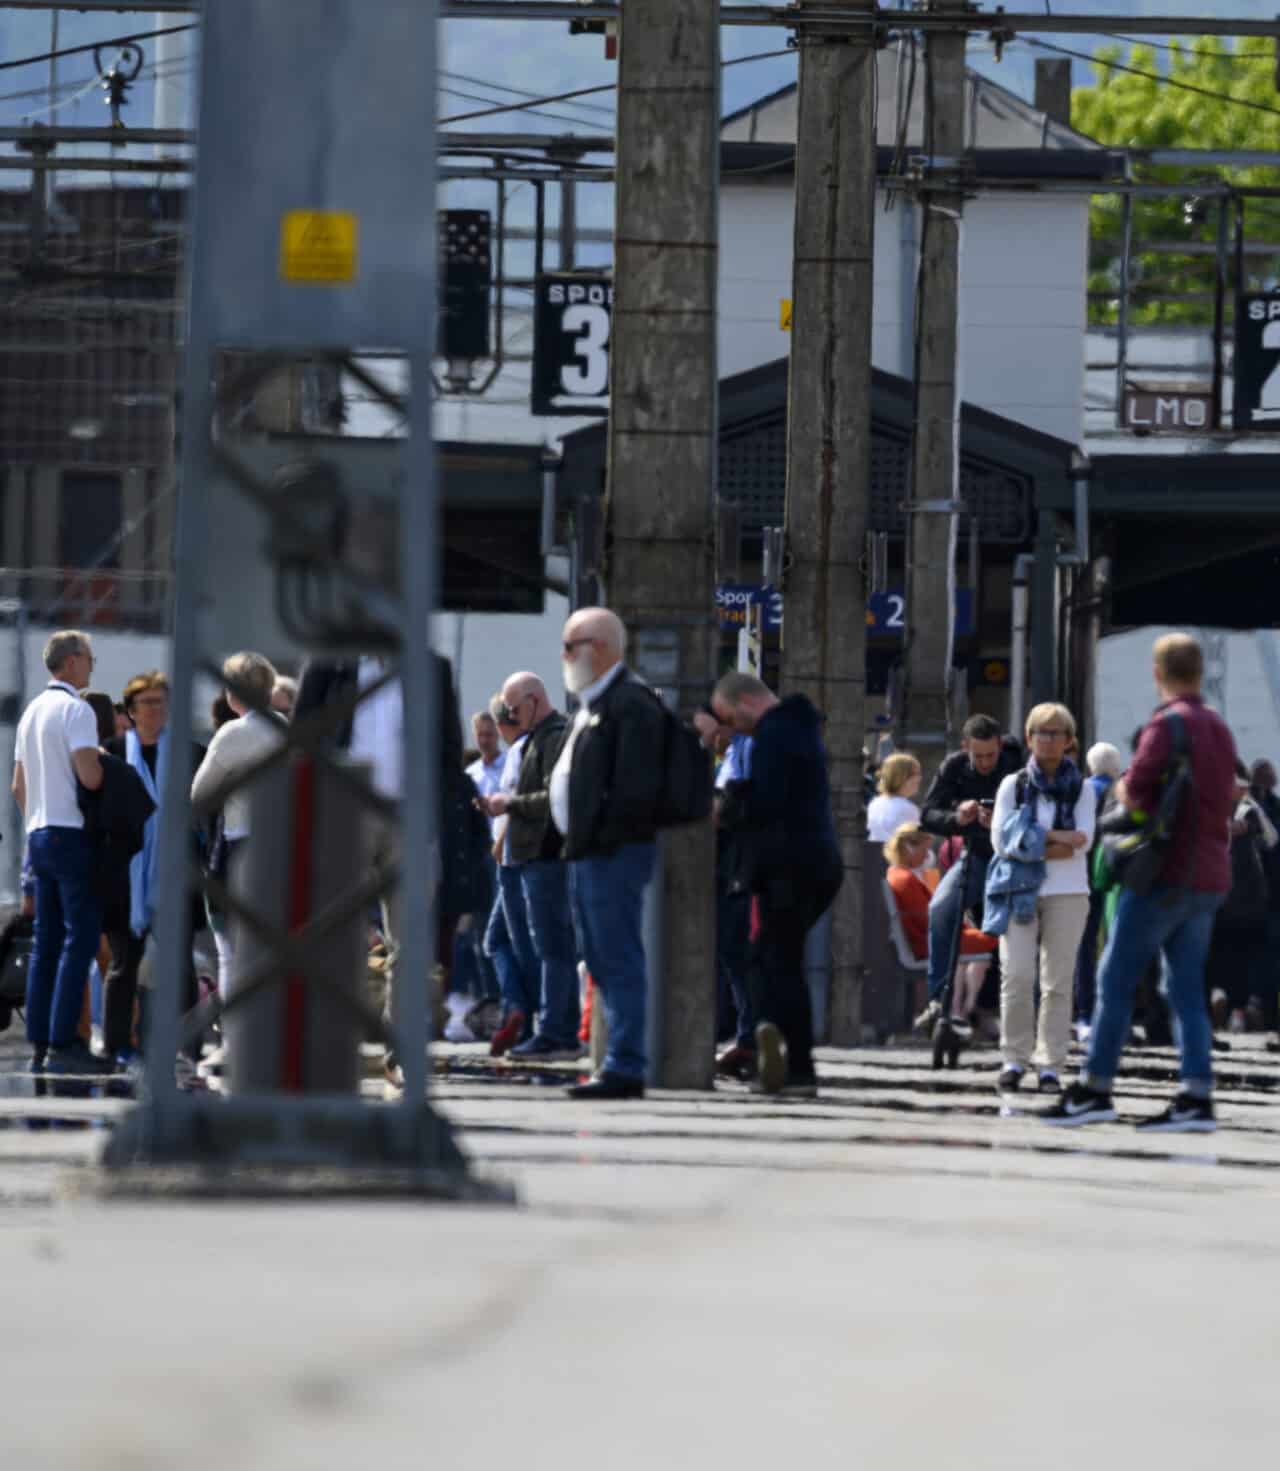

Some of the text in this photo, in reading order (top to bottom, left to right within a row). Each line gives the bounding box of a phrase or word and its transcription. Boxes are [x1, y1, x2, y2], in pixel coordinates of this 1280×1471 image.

[560, 303, 610, 394] 3
[715, 589, 754, 606] Spor
[886, 594, 904, 627] 2
